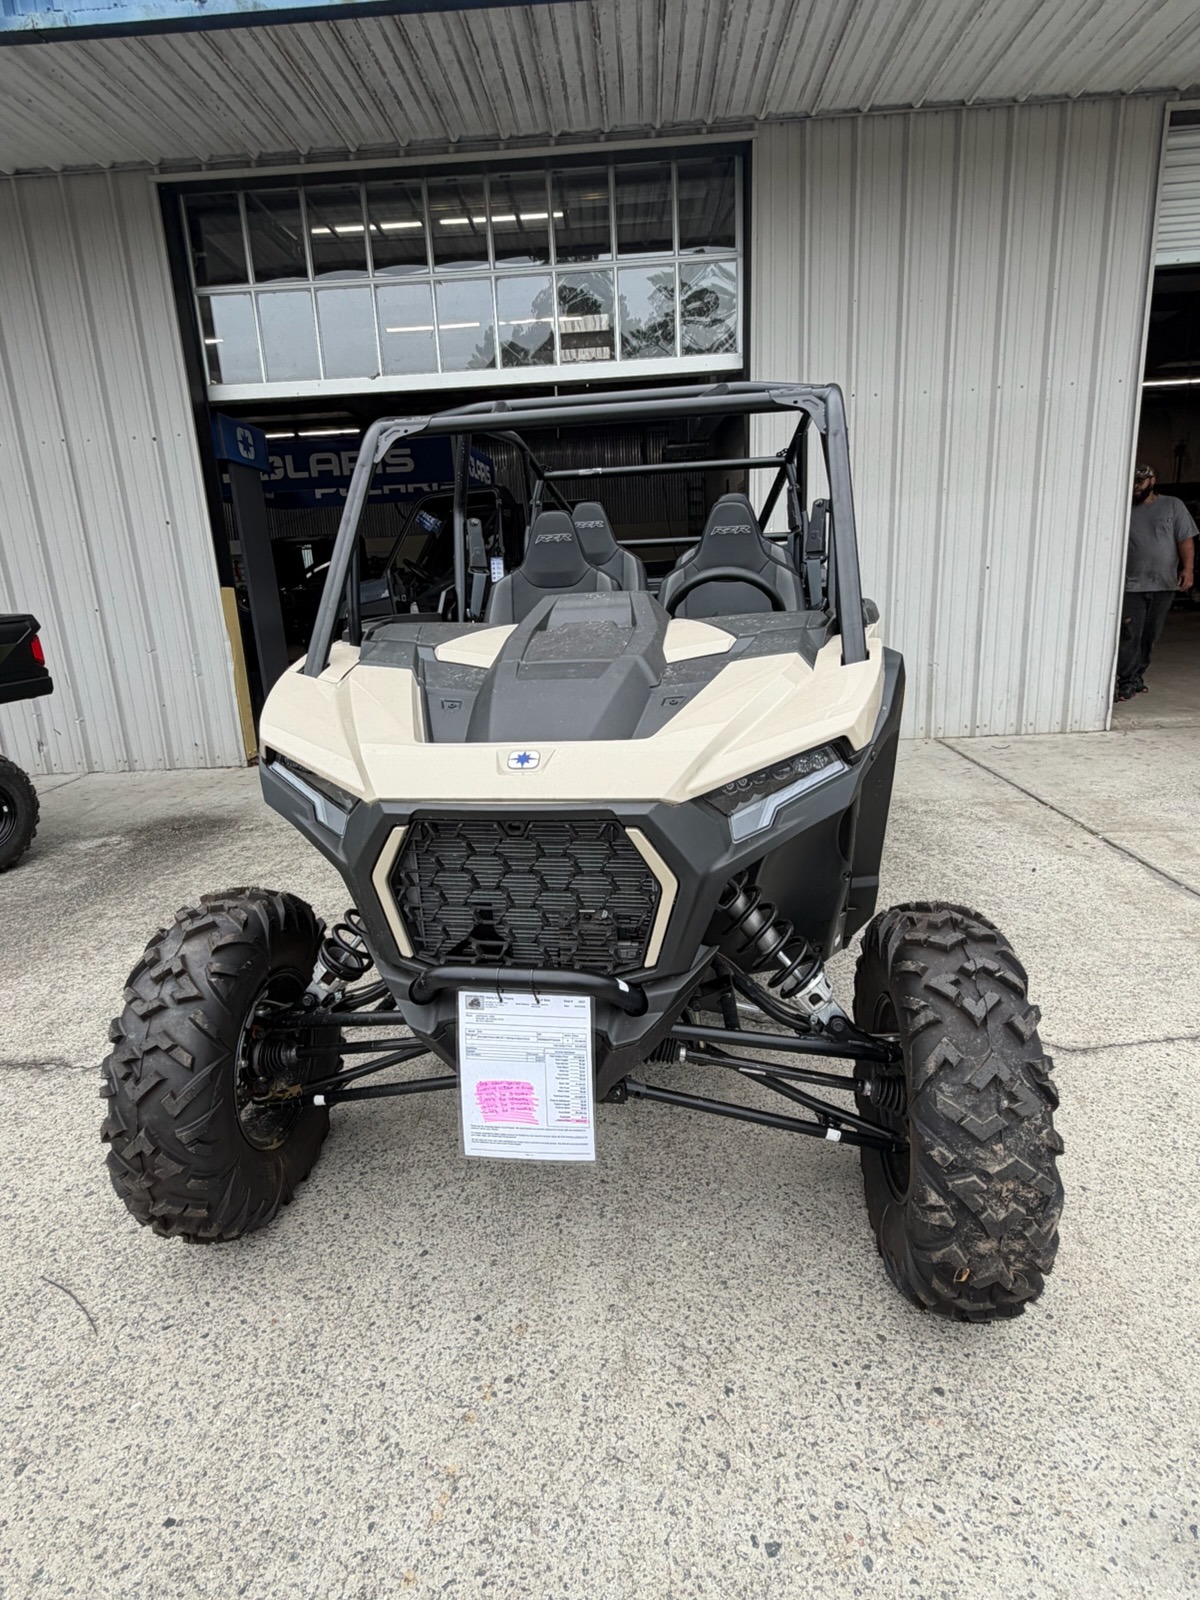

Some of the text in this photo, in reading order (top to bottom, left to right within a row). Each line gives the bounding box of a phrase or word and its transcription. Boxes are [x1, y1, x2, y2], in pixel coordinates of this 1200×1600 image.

[222, 447, 415, 484] OLAS
[711, 524, 751, 536] RZR
[535, 533, 572, 544] RZR
